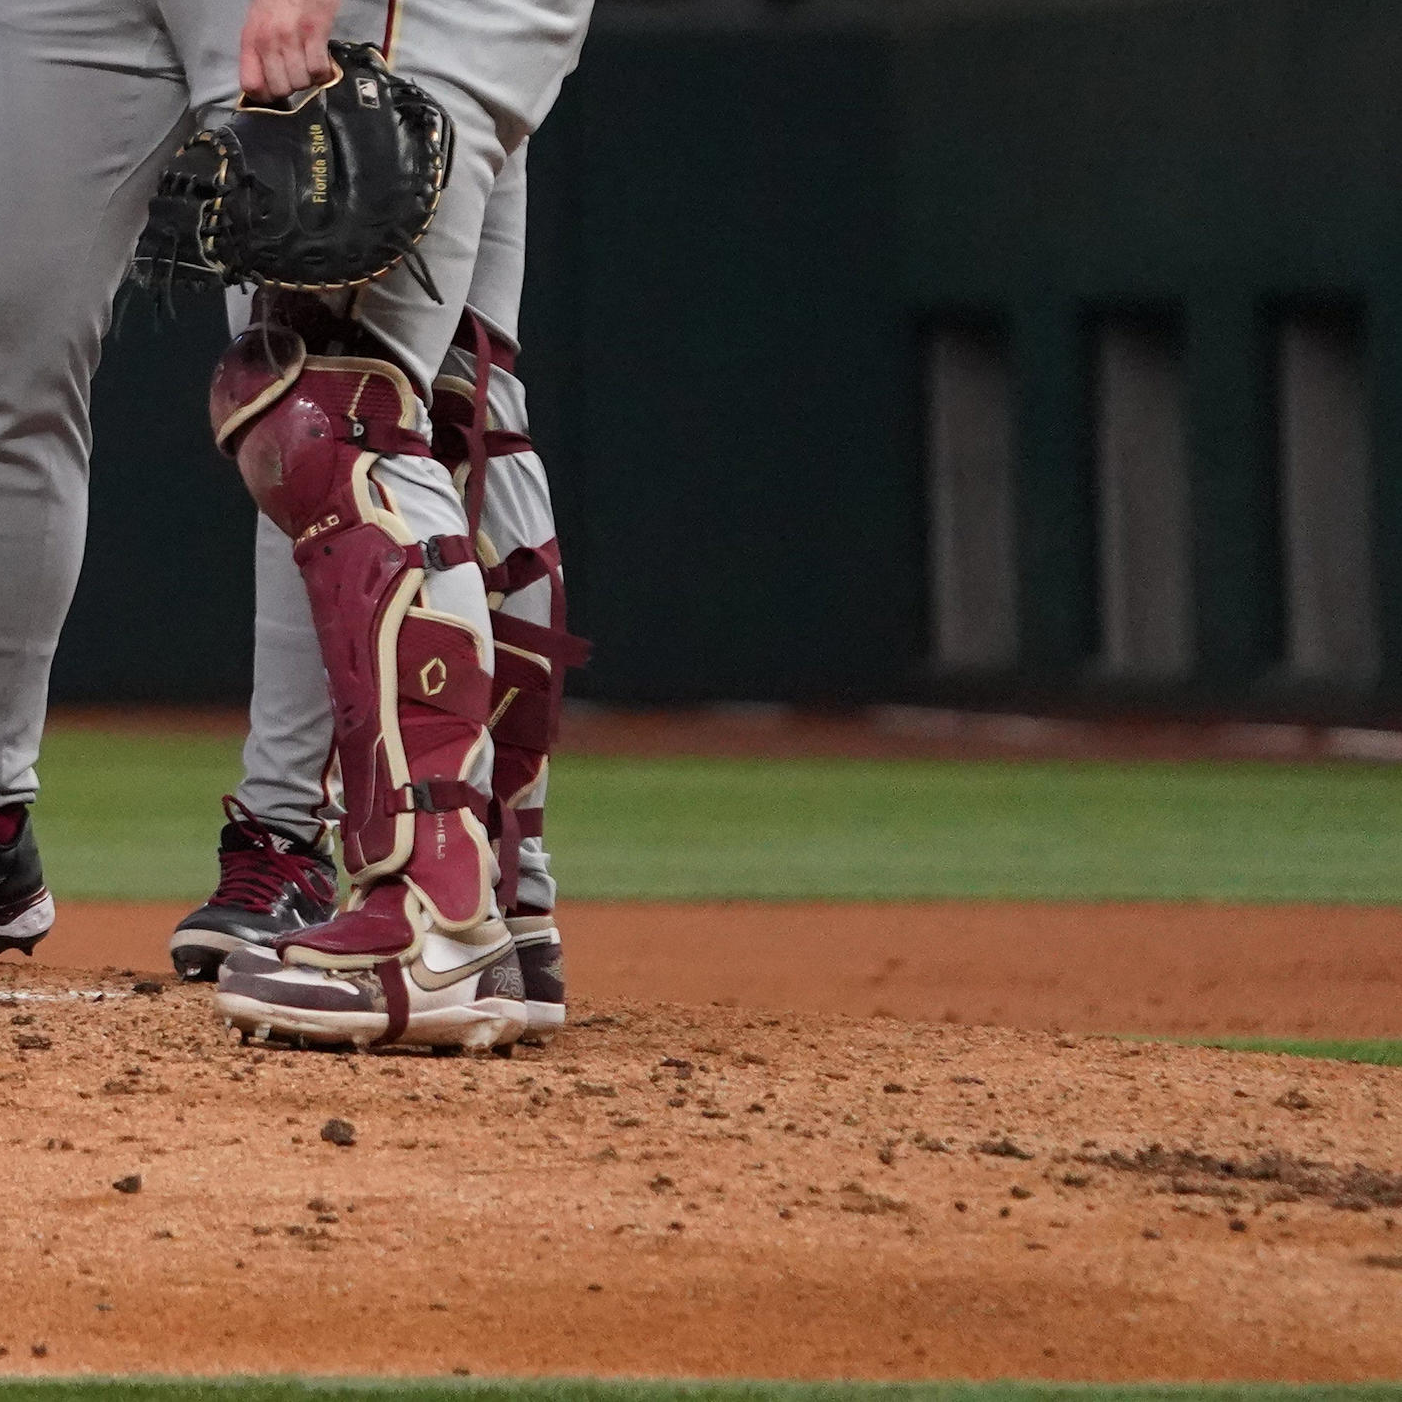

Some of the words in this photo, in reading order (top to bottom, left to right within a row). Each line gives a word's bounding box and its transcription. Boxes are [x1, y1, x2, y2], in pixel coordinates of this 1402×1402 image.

[310, 124, 325, 153] State
[312, 159, 327, 203] Florida
[492, 965, 524, 998] 25
